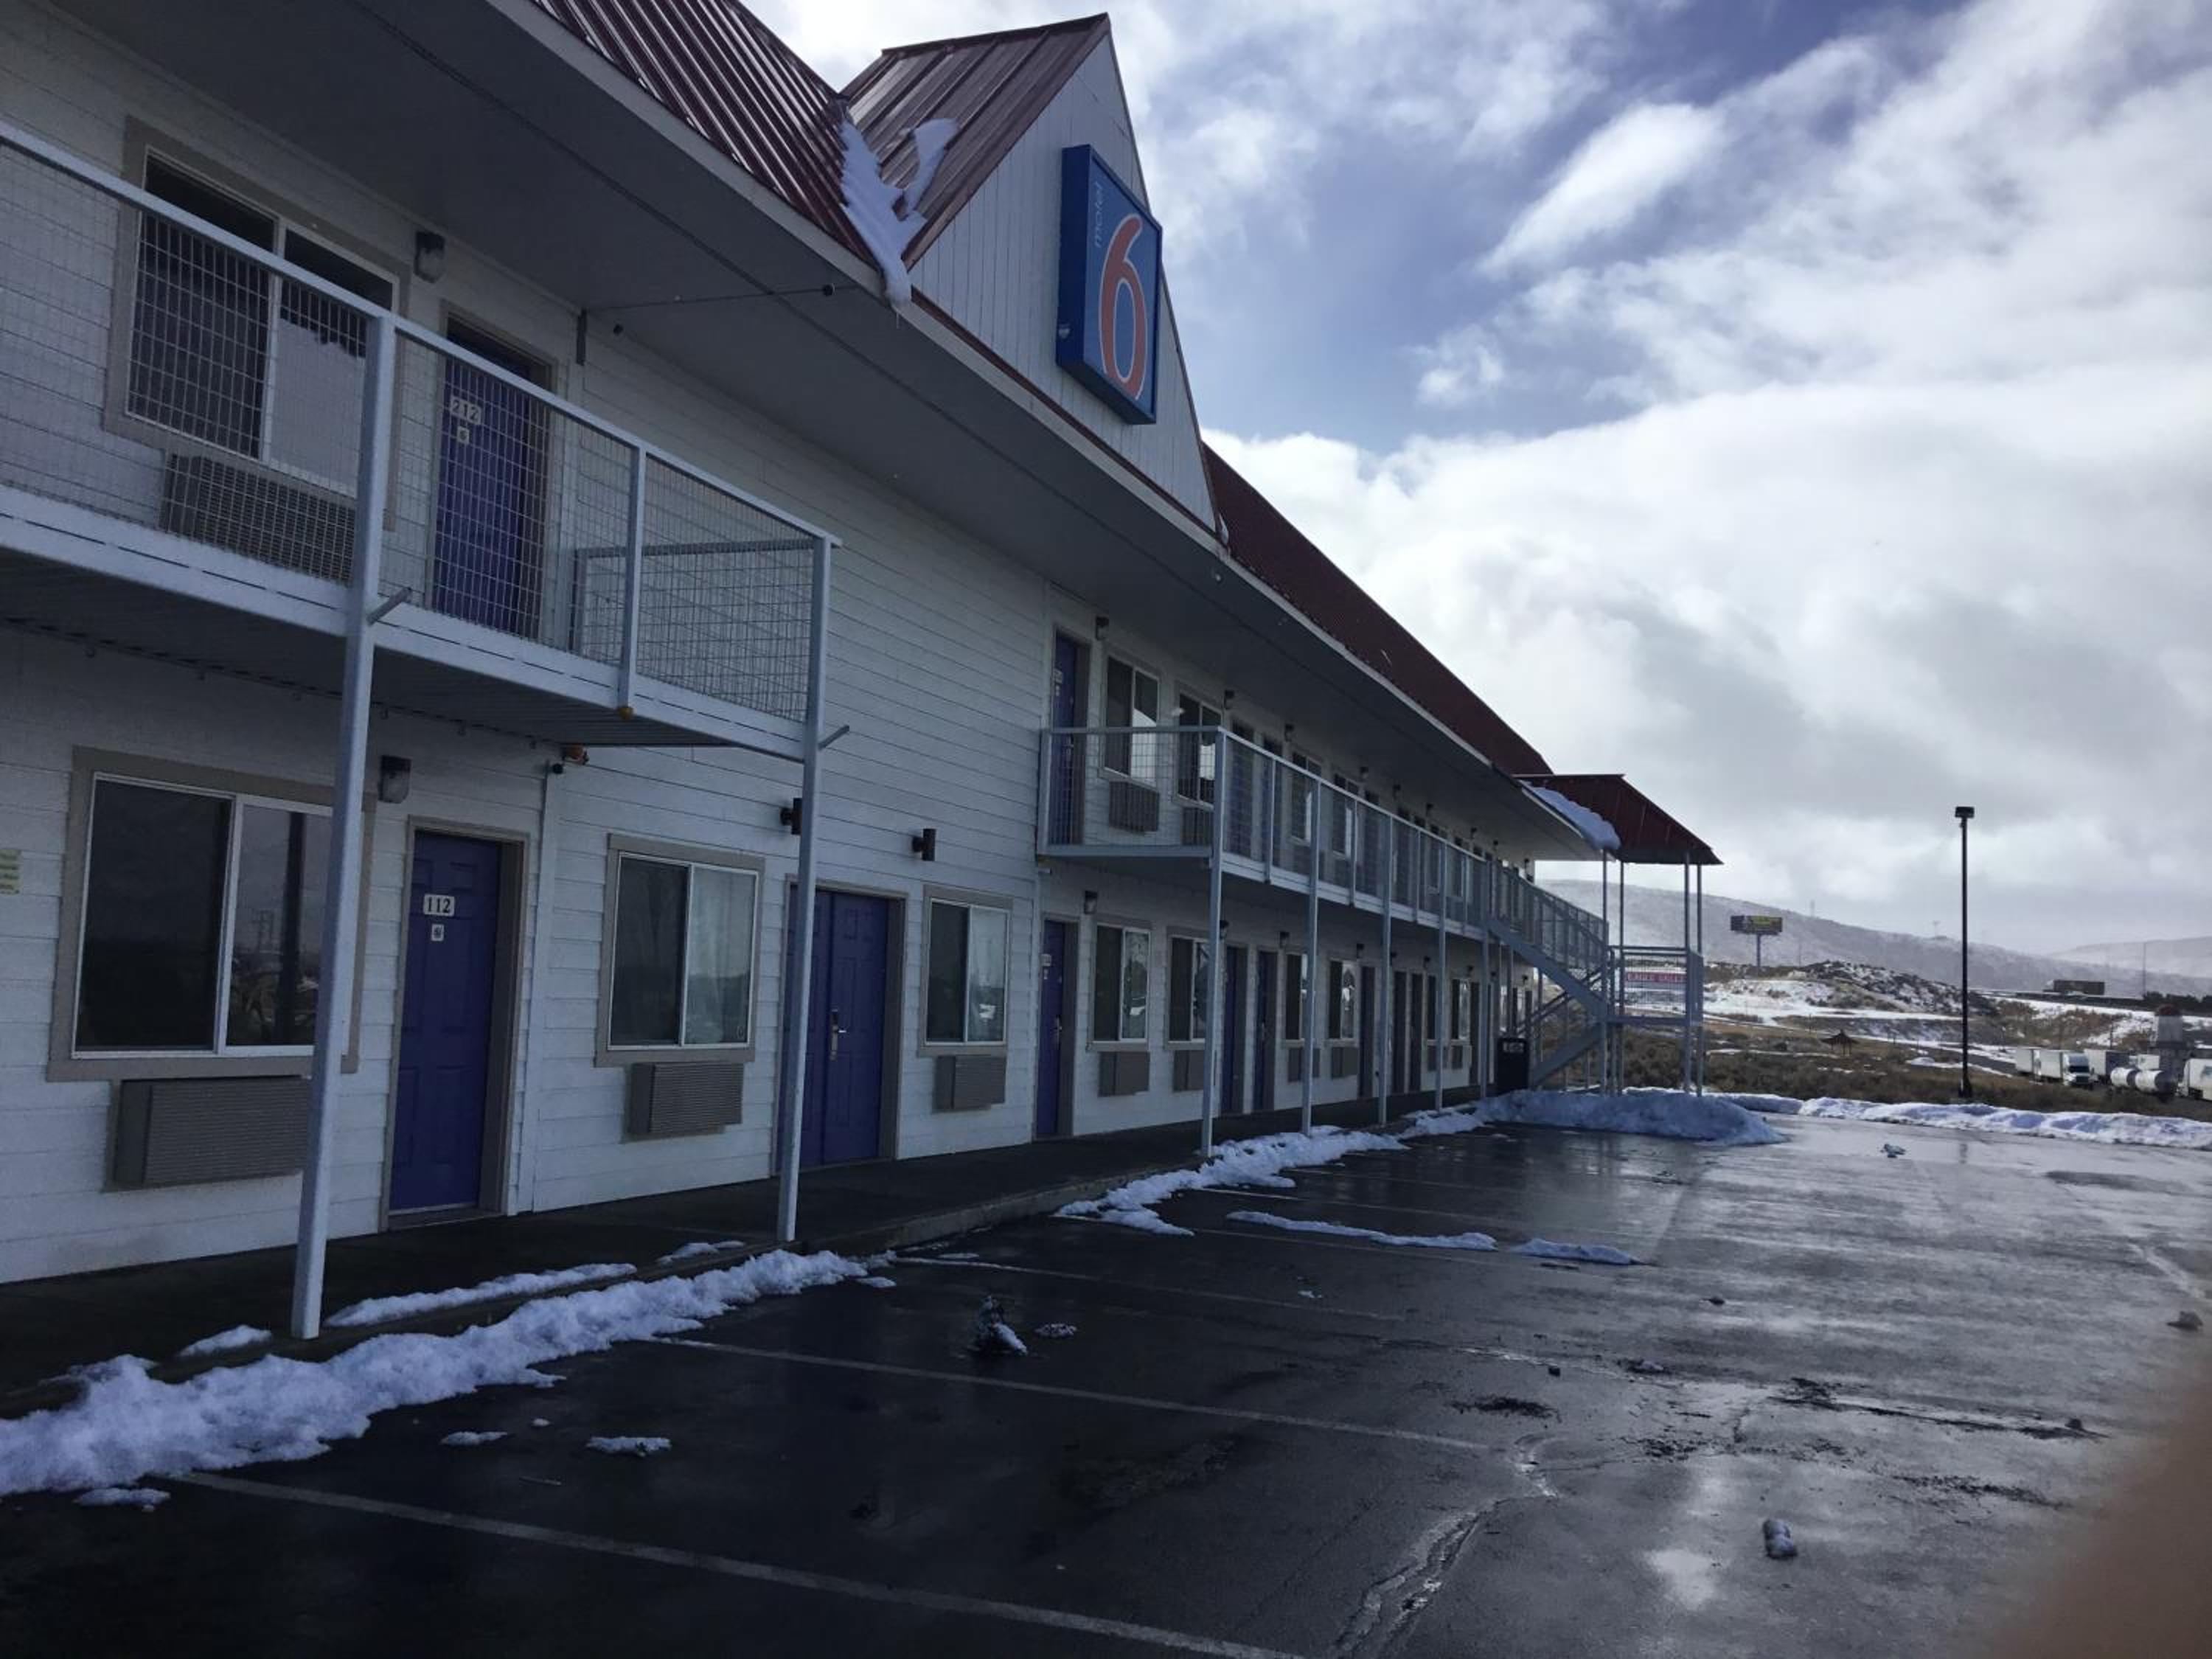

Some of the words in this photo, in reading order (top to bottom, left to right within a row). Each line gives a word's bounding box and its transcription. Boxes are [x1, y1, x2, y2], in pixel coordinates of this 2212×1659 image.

[1099, 213, 1148, 400] 6
[452, 399, 479, 421] 212
[428, 897, 451, 913] 112
